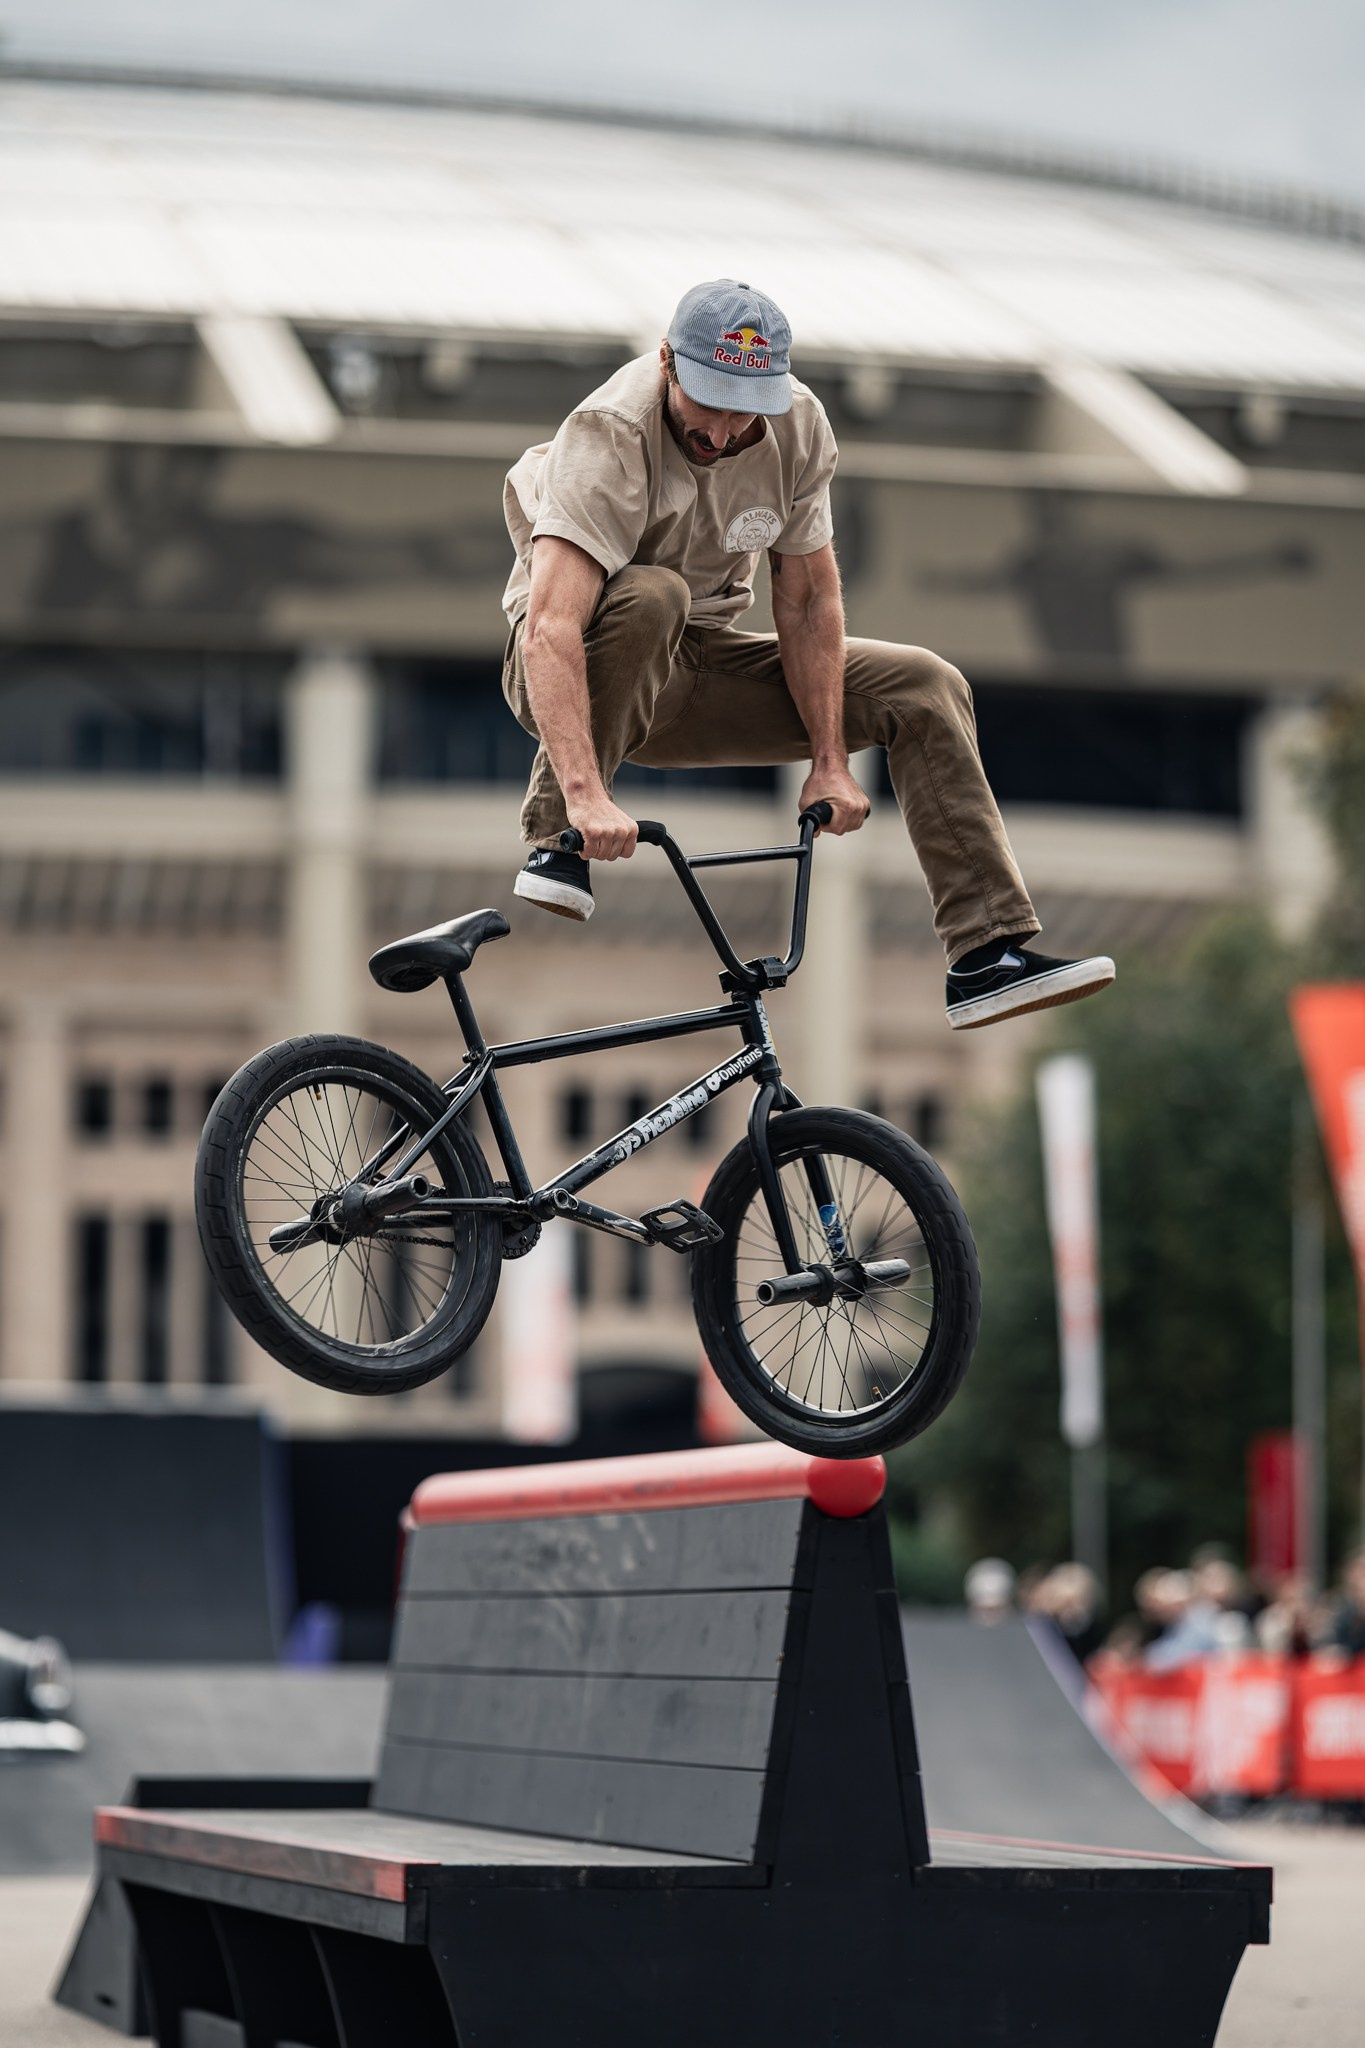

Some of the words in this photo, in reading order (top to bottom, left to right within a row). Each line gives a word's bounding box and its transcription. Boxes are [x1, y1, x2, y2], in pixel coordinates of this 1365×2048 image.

[713, 346, 744, 366] Red
[745, 352, 771, 370] Bull
[742, 510, 777, 525] ALWAYS
[720, 1047, 763, 1081] OnlyFans
